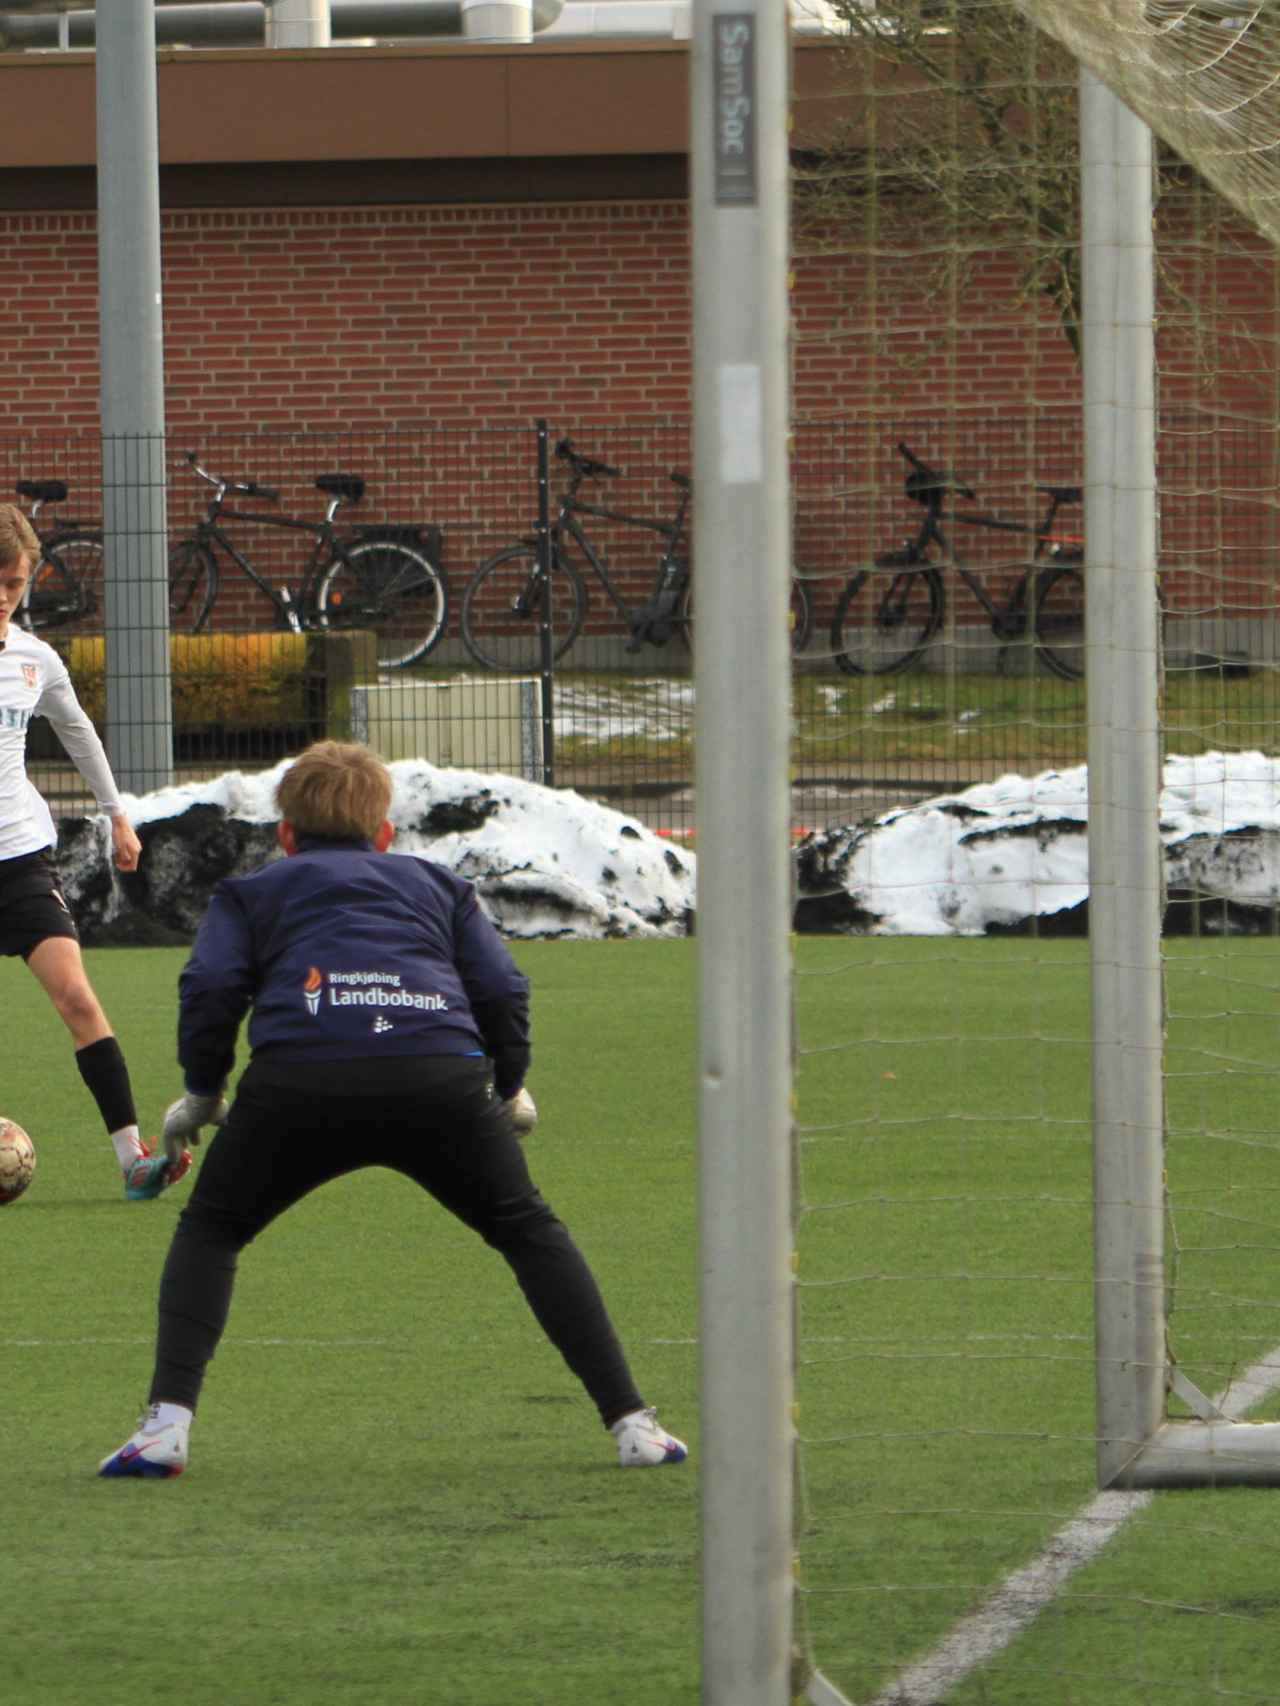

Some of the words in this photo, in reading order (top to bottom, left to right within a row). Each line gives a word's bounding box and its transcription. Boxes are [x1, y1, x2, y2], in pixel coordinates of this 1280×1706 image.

[720, 22, 750, 155] SamSoc
[329, 971, 401, 987] Ringkjøbing
[330, 988, 448, 1010] Landbobank
